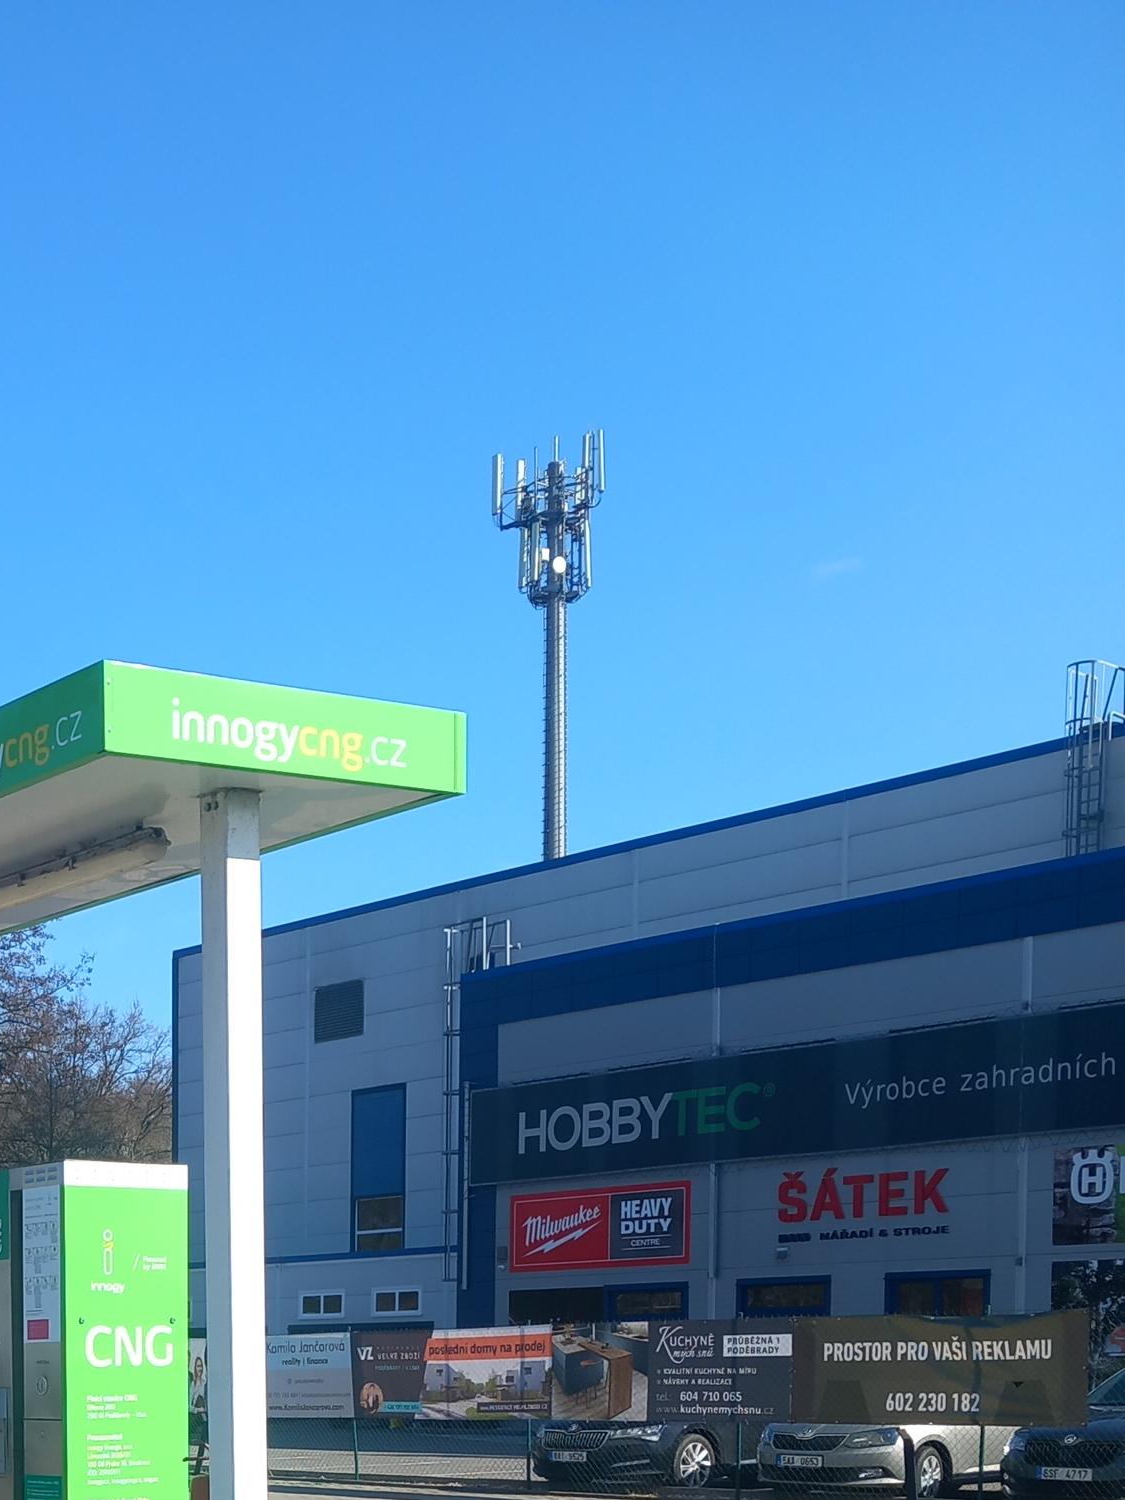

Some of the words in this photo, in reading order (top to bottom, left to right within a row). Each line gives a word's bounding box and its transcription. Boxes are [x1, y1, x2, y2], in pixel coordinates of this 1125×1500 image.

[172, 697, 408, 772] innogycng.cz
[845, 1075, 946, 1108] Výrobce
[961, 1051, 1116, 1092] zahradních
[778, 1167, 950, 1224] ŠÁTEK
[620, 1197, 672, 1220] HEAVY
[522, 1204, 602, 1247] Milwaukee
[620, 1218, 672, 1235] DUTY
[819, 1227, 873, 1241] NÁŘADÍ
[893, 1225, 950, 1237] STROJE
[630, 1238, 661, 1248] CENTRE
[90, 1281, 125, 1294] innogy
[84, 1325, 174, 1368] CNG
[299, 1340, 345, 1354] Jančarová
[428, 1342, 468, 1357] poslední
[470, 1343, 497, 1356] domy
[500, 1344, 512, 1353] na
[515, 1340, 546, 1354] prodej
[727, 1346, 780, 1355] PODĚBRADY
[823, 1342, 892, 1361] PROSTOR
[897, 1341, 929, 1361] PRO
[932, 1335, 967, 1361] VAŠI
[972, 1339, 1052, 1361] REKLAMU
[680, 1391, 699, 1402] 604
[703, 1391, 720, 1402] 710
[723, 1391, 742, 1402] 065
[886, 1393, 913, 1412] 602
[919, 1393, 946, 1412] 230
[952, 1392, 980, 1412] 182
[656, 1404, 775, 1416] www.kuchynemychsnu.cz
